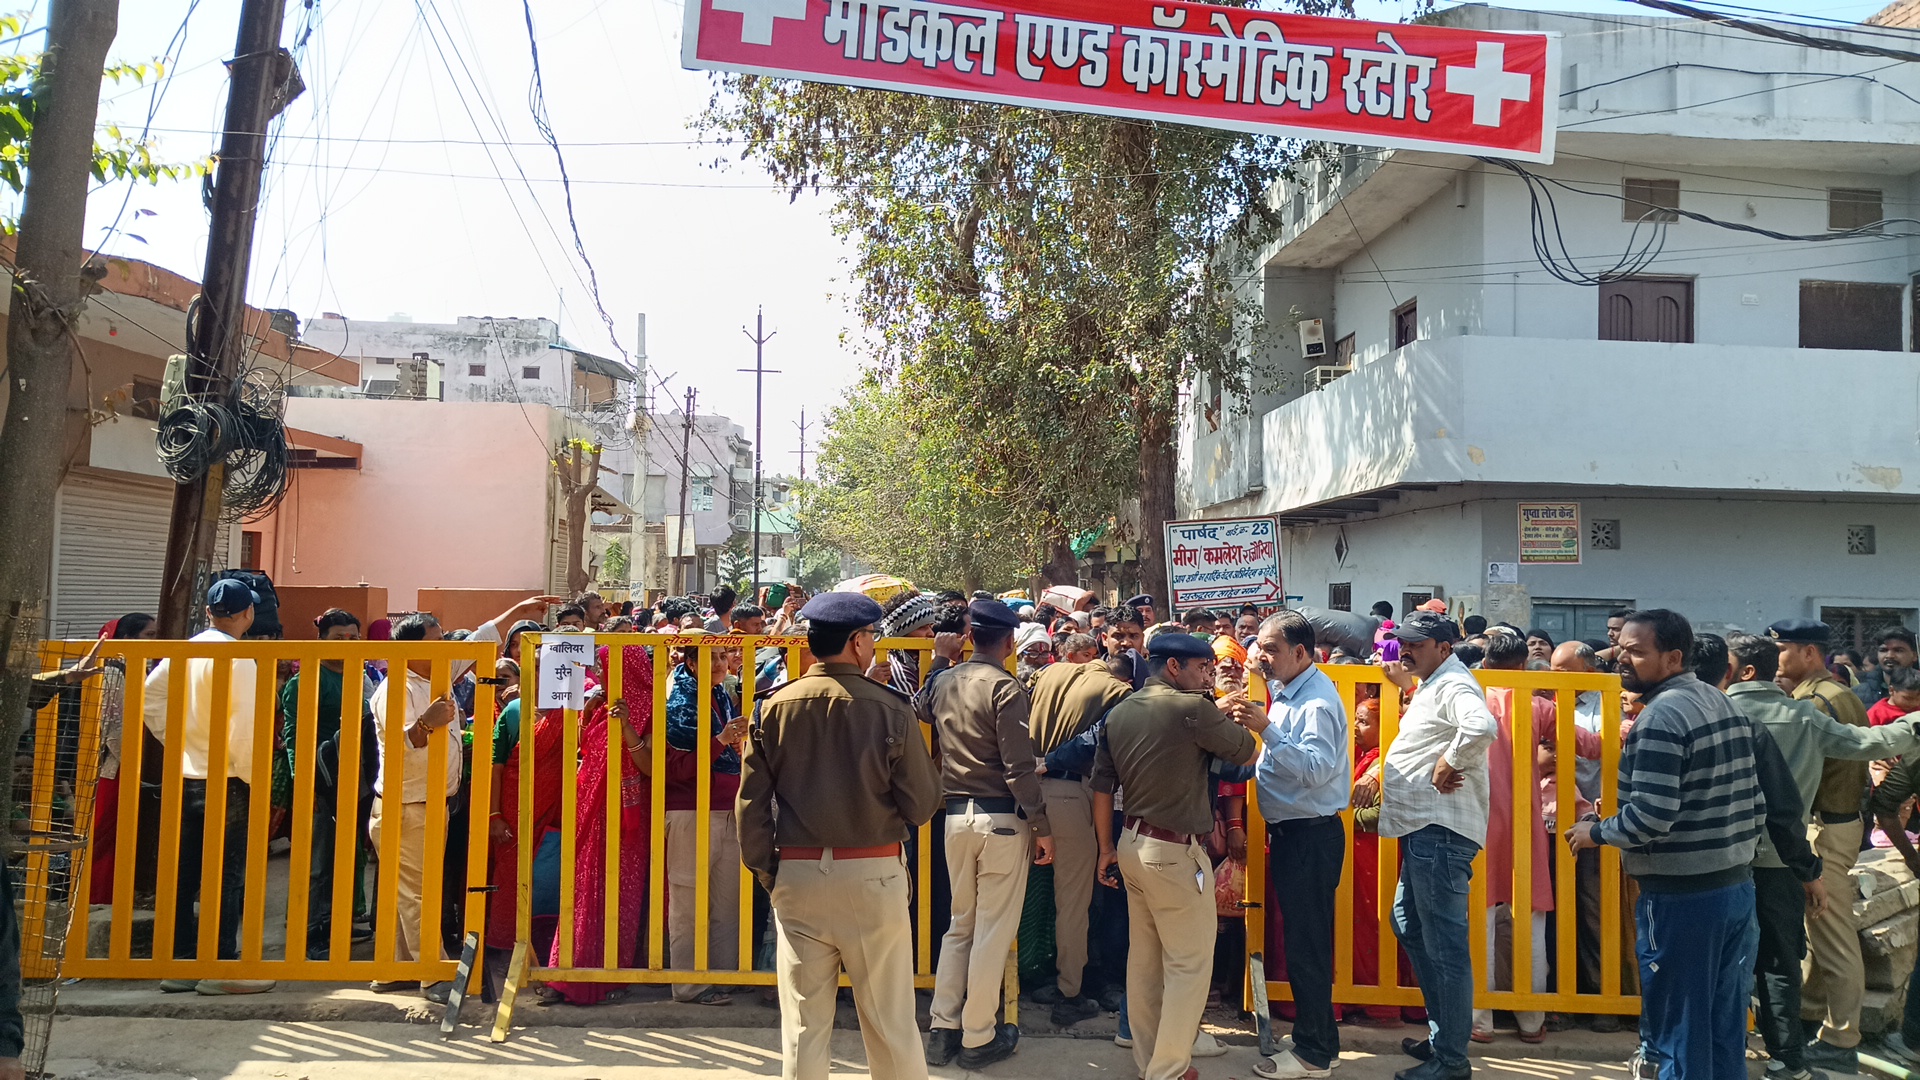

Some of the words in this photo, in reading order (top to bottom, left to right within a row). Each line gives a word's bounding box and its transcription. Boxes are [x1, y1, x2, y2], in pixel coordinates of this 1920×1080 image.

[1014, 13, 1115, 88] एण्ड
[1341, 31, 1438, 122] स्टोर
[1522, 508, 1540, 522] गुप्ता
[1541, 506, 1557, 518] लोन
[1251, 522, 1269, 536] 23
[663, 634, 693, 646] लोक
[699, 634, 744, 646] निर्माण
[754, 635, 787, 646] लोक
[554, 664, 572, 681] मुरैन
